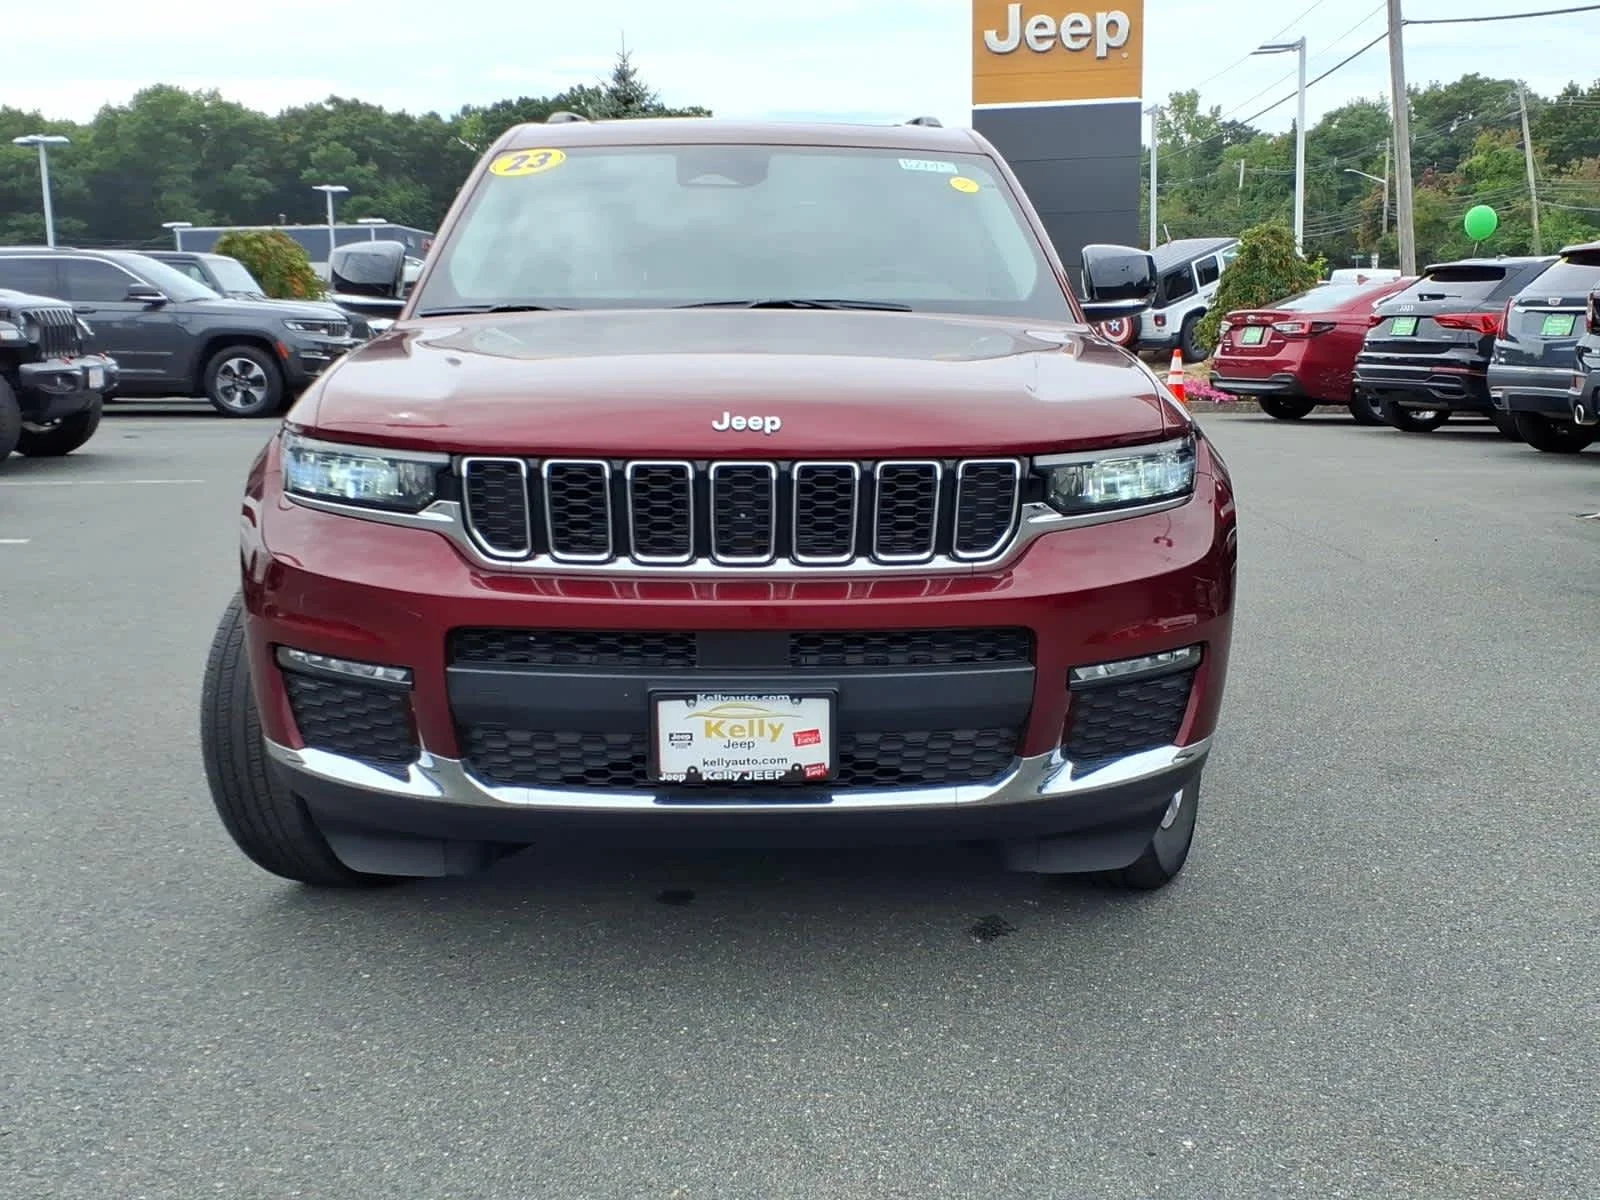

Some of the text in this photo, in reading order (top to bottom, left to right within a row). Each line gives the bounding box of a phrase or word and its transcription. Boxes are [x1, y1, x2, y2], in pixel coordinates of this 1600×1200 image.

[984, 3, 1130, 57] Jeep
[504, 152, 552, 171] 23
[711, 411, 781, 434] Jeep
[704, 719, 784, 742] Kelly
[723, 739, 755, 750] Jeep
[702, 757, 788, 768] kellyauto.com
[659, 773, 686, 782] Jeep
[702, 770, 786, 781] Kelly JEEP
